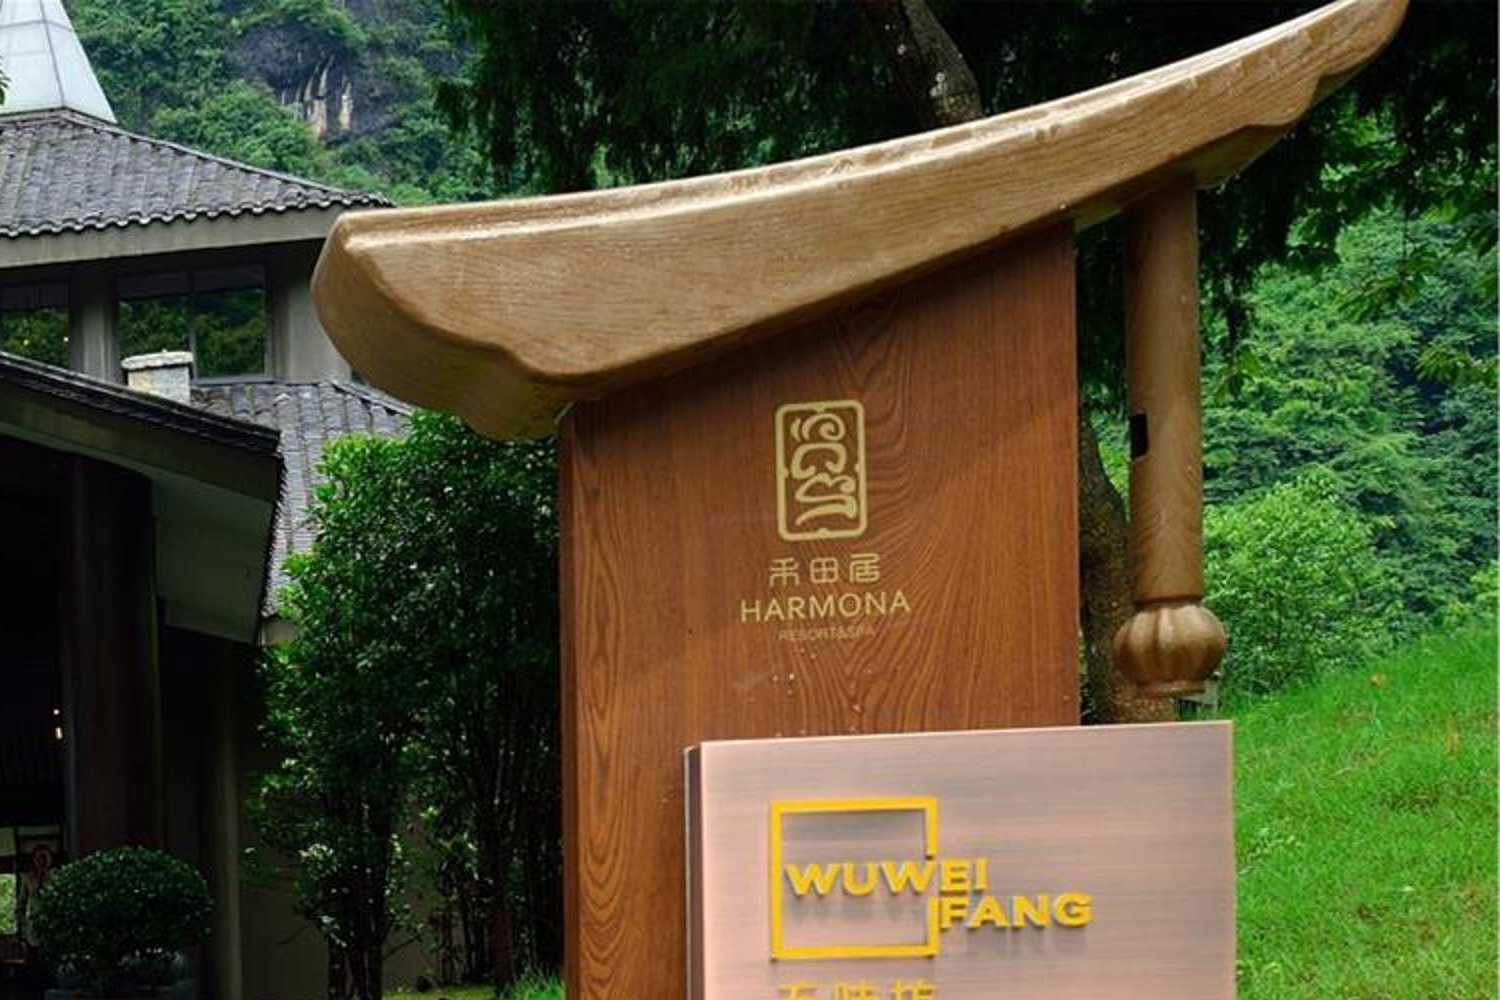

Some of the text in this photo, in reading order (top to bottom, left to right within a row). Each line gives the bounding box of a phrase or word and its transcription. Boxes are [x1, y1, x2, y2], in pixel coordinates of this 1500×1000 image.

[769, 553, 881, 587] 禾田居
[740, 590, 912, 623] HARMONA
[785, 857, 990, 896] WUWEI
[939, 891, 1092, 930] FANG
